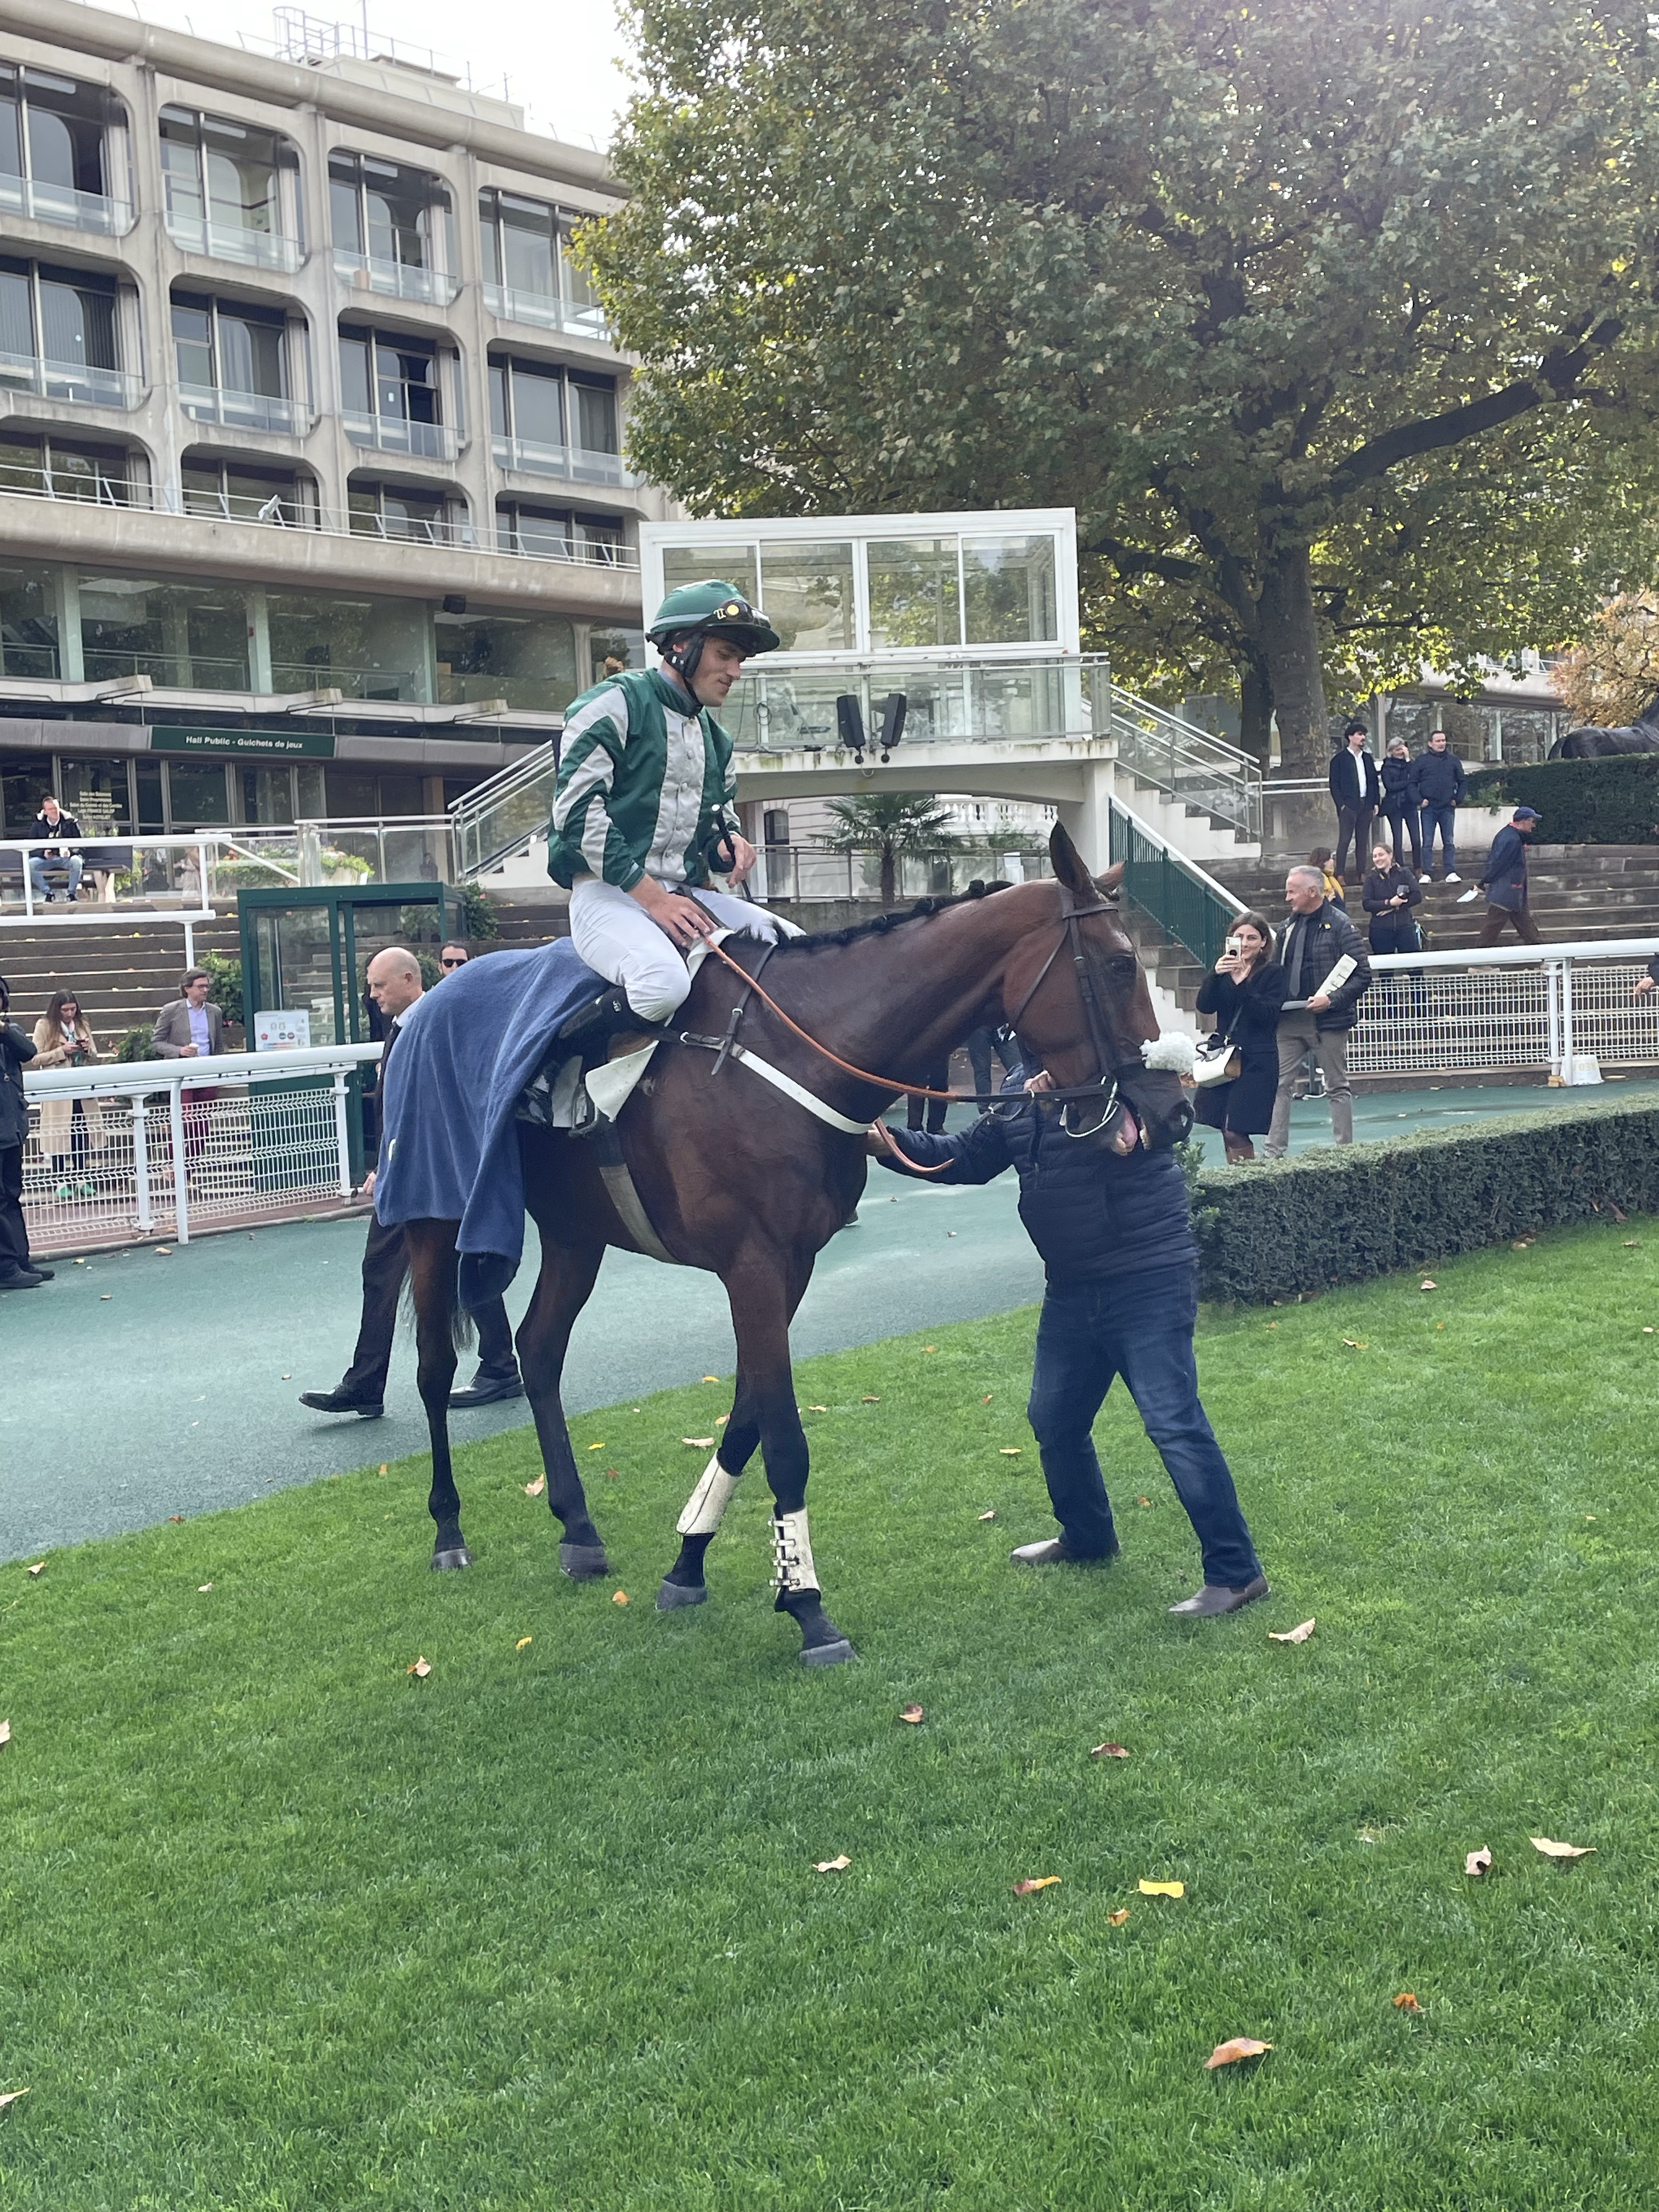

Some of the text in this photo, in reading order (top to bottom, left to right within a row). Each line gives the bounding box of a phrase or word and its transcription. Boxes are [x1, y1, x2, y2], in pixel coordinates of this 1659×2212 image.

[204, 736, 230, 745] Public
[237, 738, 273, 747] Guichets
[286, 741, 303, 750] jeux
